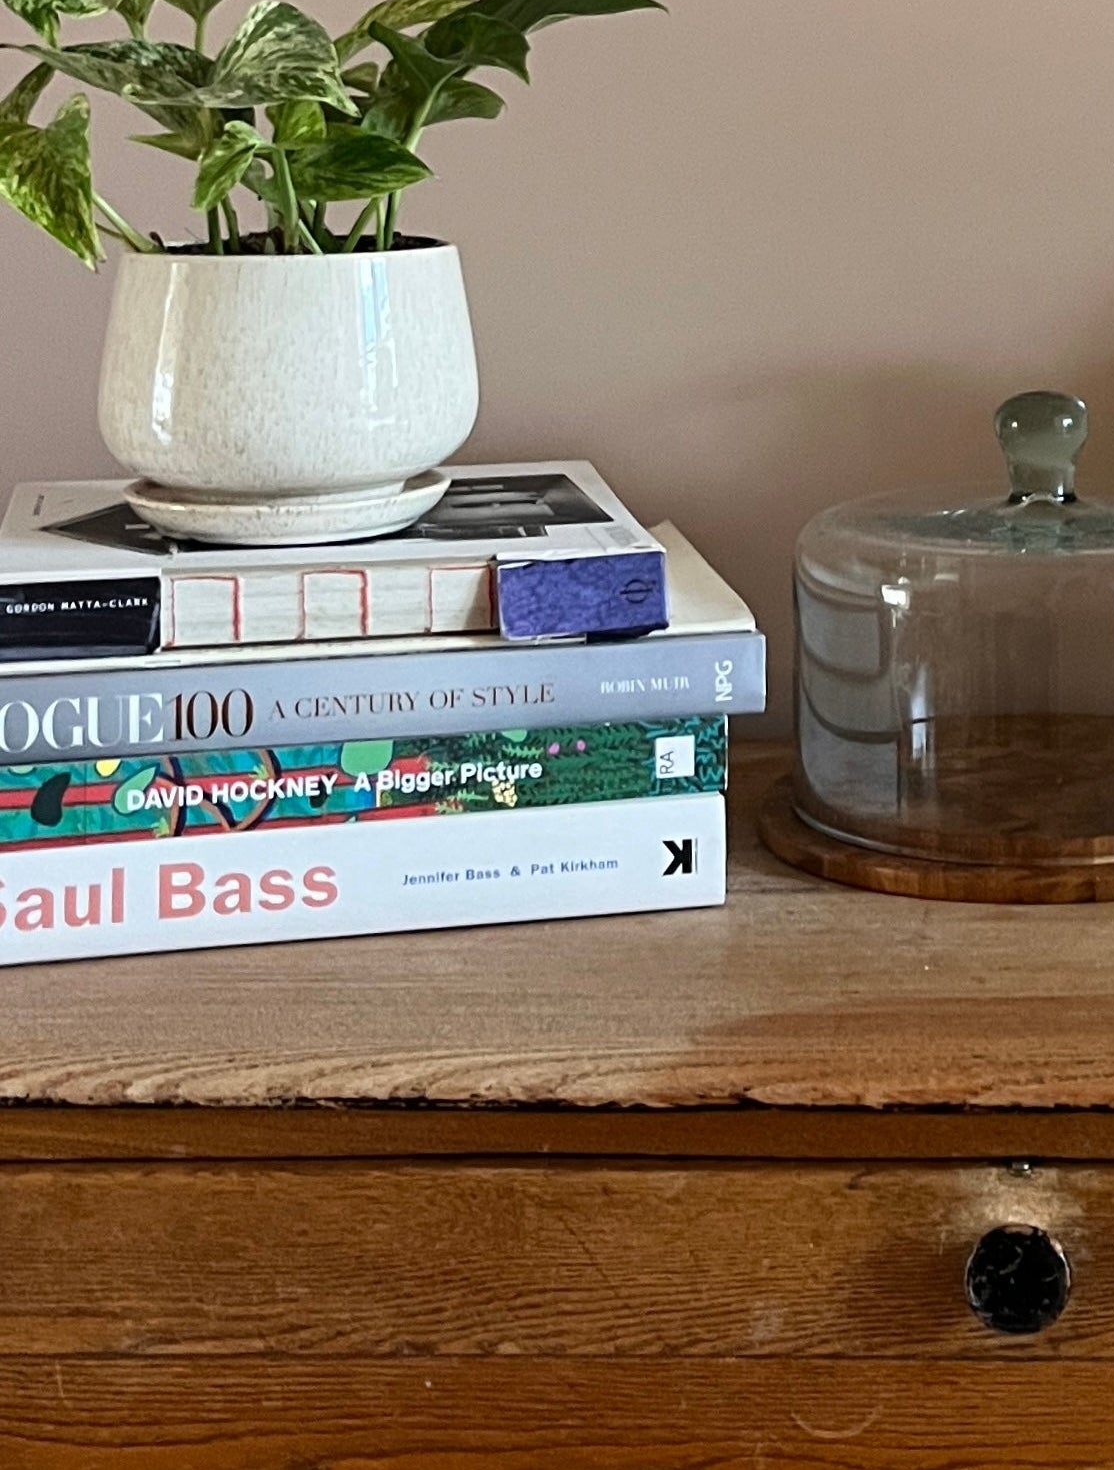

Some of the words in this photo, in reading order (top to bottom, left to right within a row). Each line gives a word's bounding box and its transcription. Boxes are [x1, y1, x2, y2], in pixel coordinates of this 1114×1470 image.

[6, 602, 55, 614] GORDON
[61, 597, 148, 611] MATTA-CLARK
[600, 679, 645, 694] ROBIN
[651, 676, 690, 691] MUIR
[715, 659, 733, 702] NPG
[269, 699, 286, 721] A
[294, 690, 421, 718] CENTURY
[429, 687, 465, 710] OF
[471, 682, 556, 708] STYLE
[354, 772, 372, 793] A
[376, 769, 454, 793] Bigger
[460, 761, 542, 784] Picture
[659, 750, 675, 775] RA
[126, 785, 204, 812] DAVID
[211, 773, 339, 805] HOCKNEY
[402, 870, 460, 886] Jennifer
[465, 868, 501, 881] Bass
[510, 865, 522, 878] &
[530, 863, 555, 876] Pat
[560, 858, 619, 873] Kirkham
[158, 862, 339, 920] Bass
